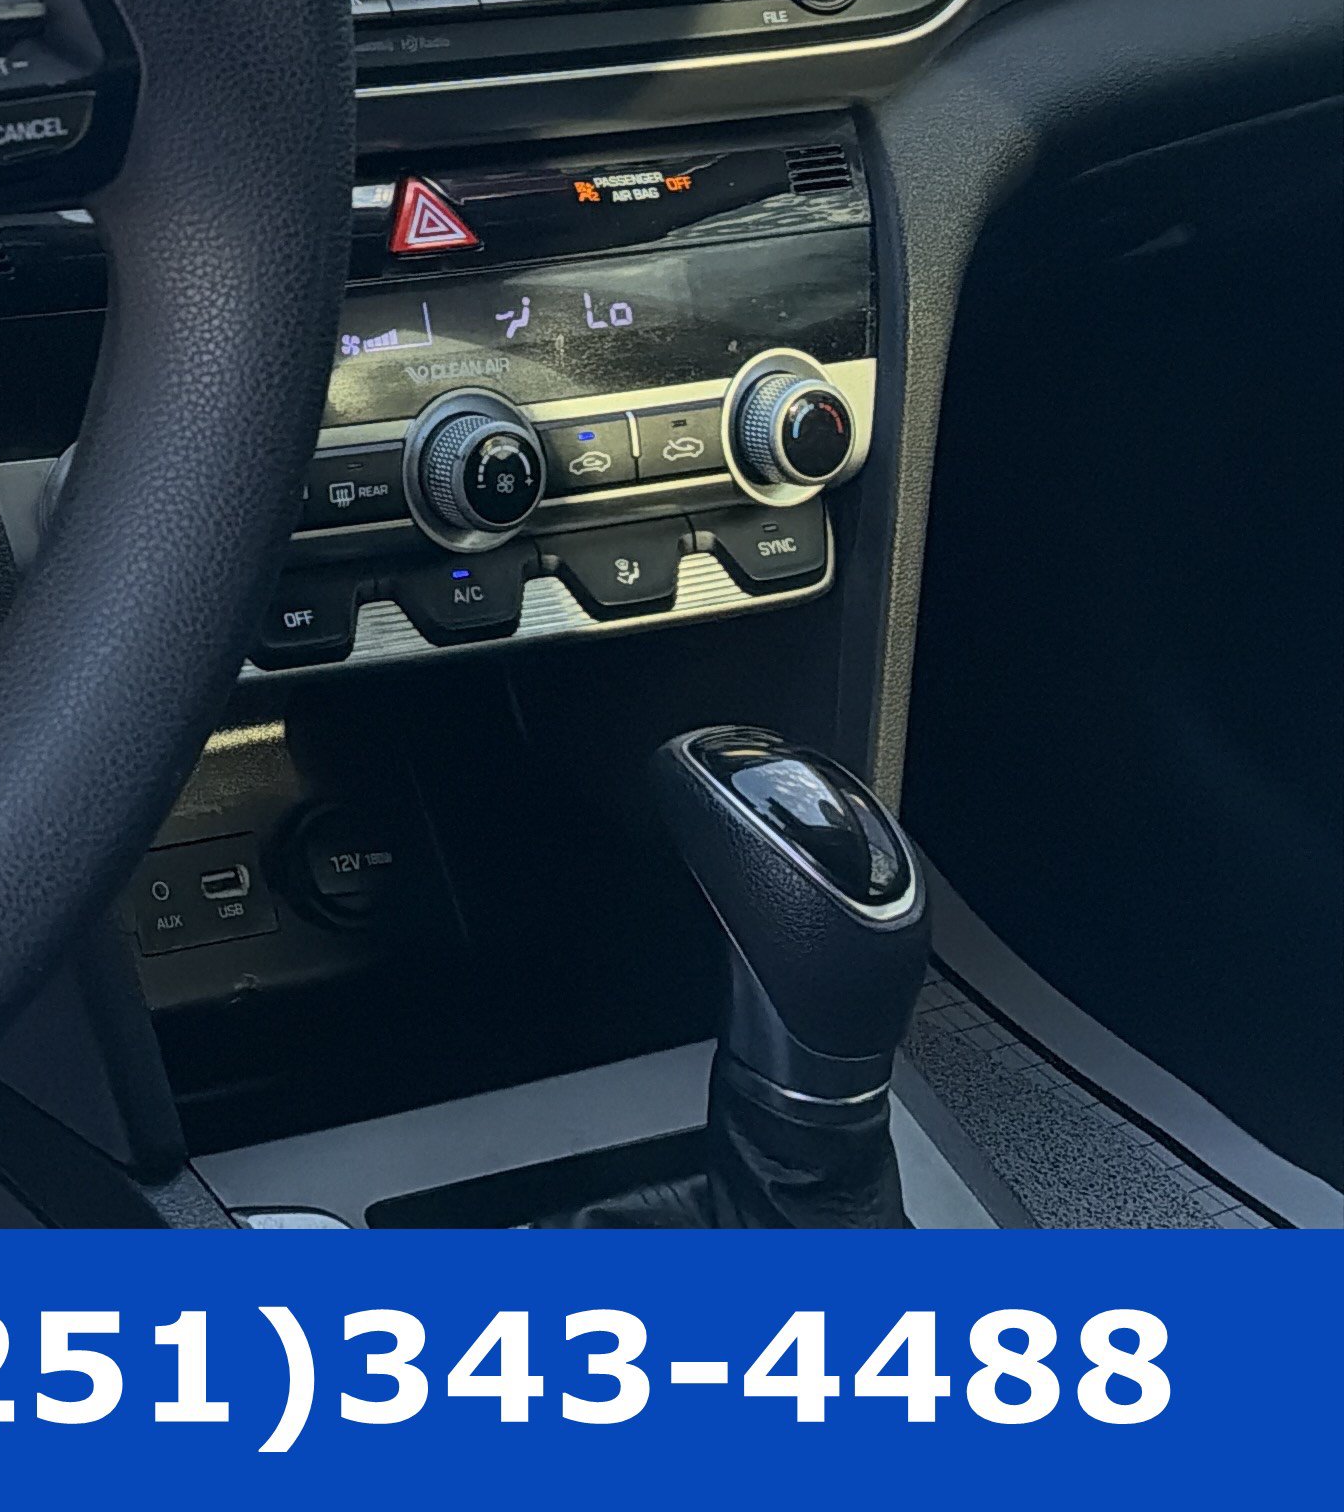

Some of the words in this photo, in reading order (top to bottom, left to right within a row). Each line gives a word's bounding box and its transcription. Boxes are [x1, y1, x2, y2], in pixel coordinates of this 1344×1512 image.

[762, 9, 789, 25] FILE
[593, 171, 664, 189] PASSENGER
[664, 175, 692, 192] OFF
[612, 189, 633, 203] AIR
[632, 187, 660, 201] BAG
[431, 359, 485, 381] CLEAN
[485, 356, 511, 376] AIR
[358, 482, 389, 499] REAR
[757, 537, 798, 557] SYNC
[453, 584, 484, 604] A/C
[283, 609, 313, 629] OFF
[330, 852, 360, 873] 12V
[218, 902, 245, 919] USB
[156, 913, 184, 931] AUX
